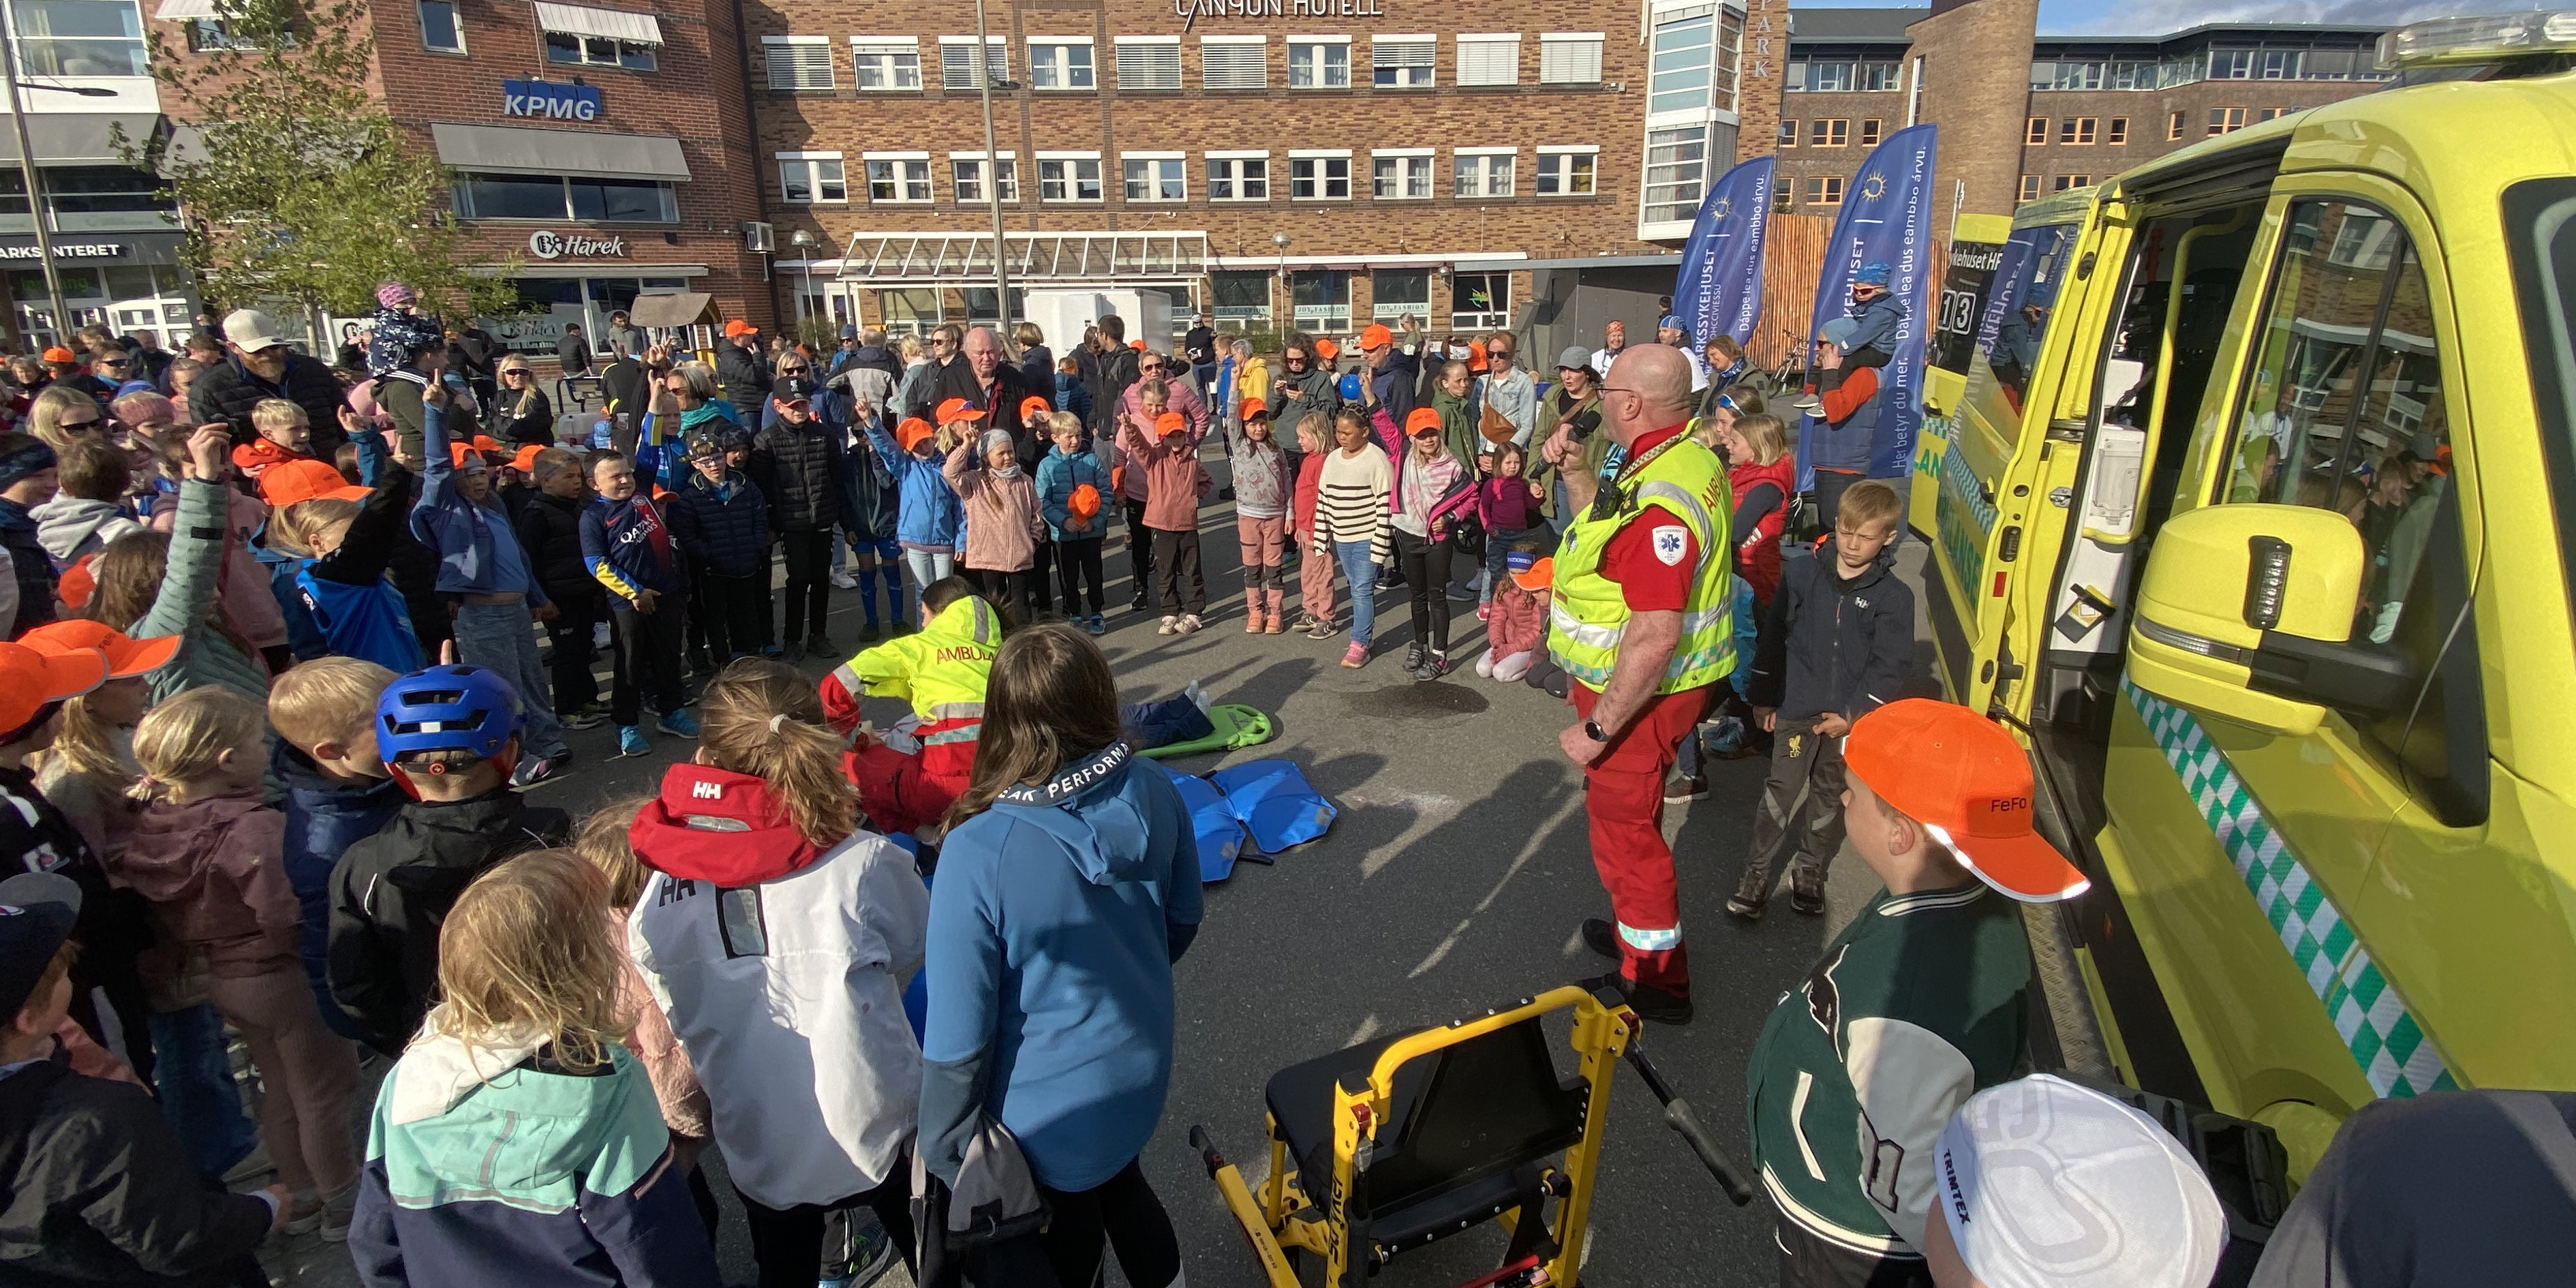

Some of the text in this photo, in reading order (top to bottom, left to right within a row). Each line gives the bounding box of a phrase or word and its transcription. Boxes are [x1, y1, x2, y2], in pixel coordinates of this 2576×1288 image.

[1294, 0, 1383, 16] HOTELL
[504, 94, 596, 121] KPMG
[1904, 185, 1920, 245] eambbo
[1749, 205, 1762, 252] eambbo
[0, 243, 120, 259] ARKSNTERET
[564, 235, 624, 257] Hårek
[1746, 254, 1756, 275] dus
[1898, 247, 1914, 273] dus
[1986, 251, 2004, 271] HF
[1742, 277, 1752, 294] lea
[1898, 275, 1913, 296] lea
[1897, 356, 1909, 388] mer.
[1892, 391, 1907, 410] du
[1892, 412, 1910, 448] betyr
[1854, 596, 1871, 609] HH
[936, 646, 995, 665] AMBULA
[998, 743, 1130, 801] EAK PERFORMA
[692, 781, 722, 799] HH
[1991, 797, 2027, 812] FeFo
[659, 878, 697, 907] HH
[1944, 1148, 1972, 1225] TRIMTEX
